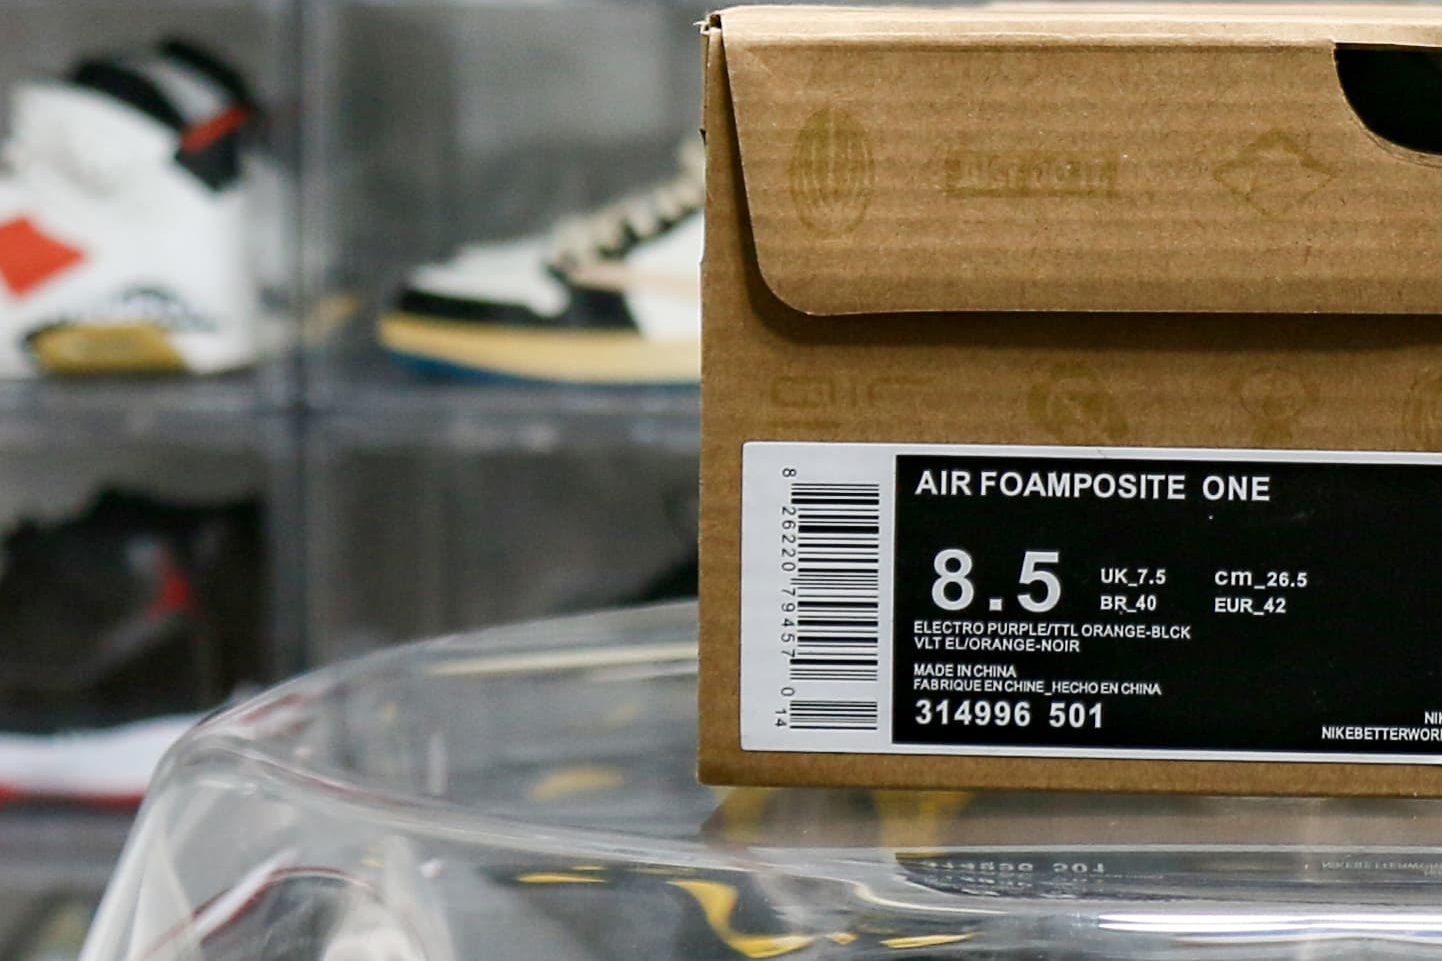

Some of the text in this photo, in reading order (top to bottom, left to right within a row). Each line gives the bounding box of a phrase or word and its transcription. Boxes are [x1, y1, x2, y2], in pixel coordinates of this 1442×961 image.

[914, 470, 1271, 502] AIR FOAMPOSITE ONE
[930, 548, 1063, 614] 8.5
[1100, 567, 1308, 590] UK_7.5 cm_26.5
[774, 467, 797, 729] 8 26220 79457 0 14
[1100, 595, 1287, 616] BR_40 EUR_42
[913, 620, 1192, 640] ELECTRO PURPLE/TTL ORANGE-BLCK
[914, 636, 1081, 653] VLT EL/ORANGE-NOIR
[913, 663, 1017, 678] MADE IN CHINA
[913, 679, 982, 692] FABRIQUE
[984, 679, 1003, 692] EN
[1101, 682, 1119, 695] EN
[1121, 682, 1162, 696] CHINA
[914, 698, 1104, 729] 314996 501
